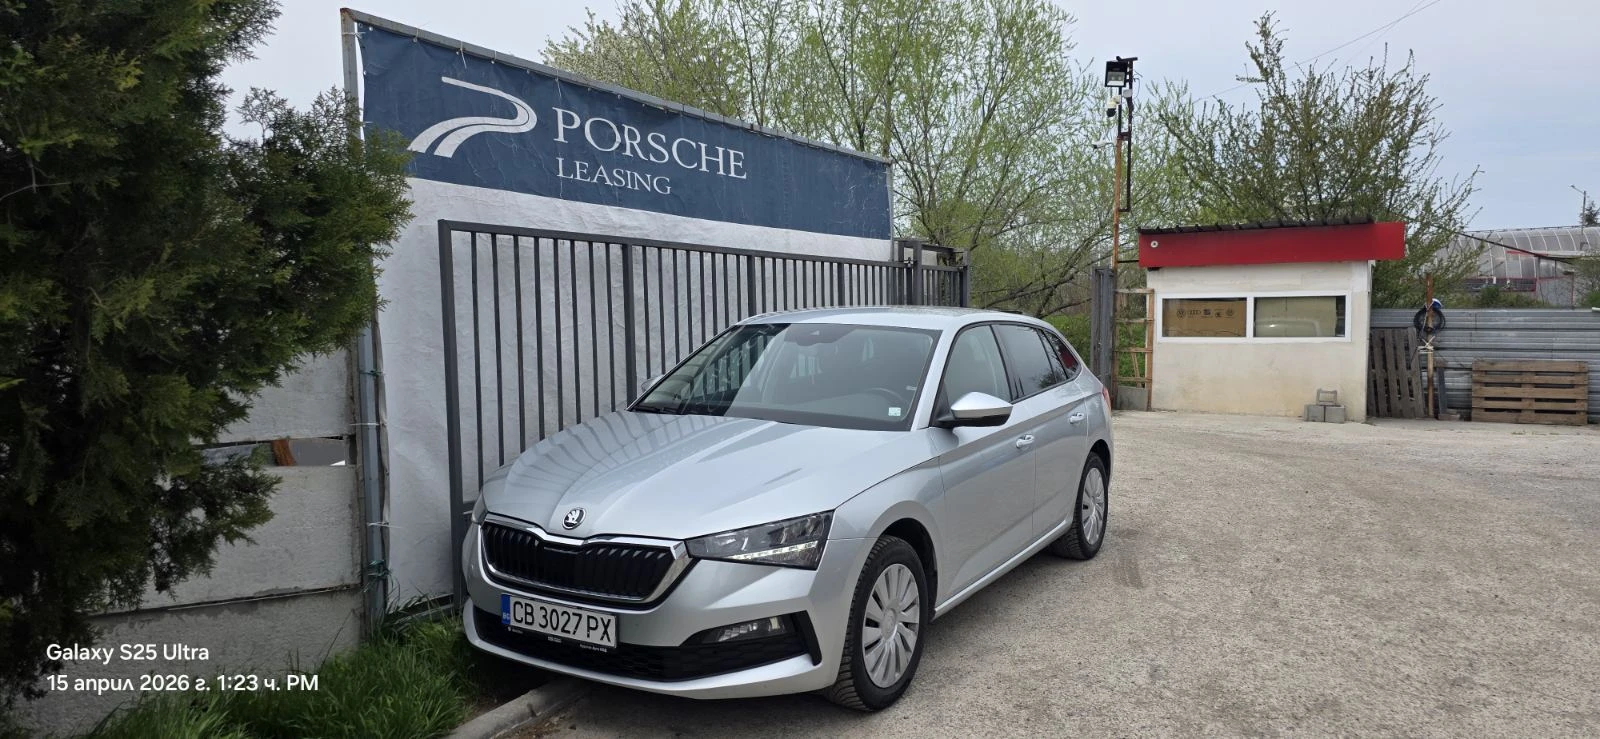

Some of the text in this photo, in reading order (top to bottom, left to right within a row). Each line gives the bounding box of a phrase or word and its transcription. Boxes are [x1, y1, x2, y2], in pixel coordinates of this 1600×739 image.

[552, 107, 747, 179] PORSCHE
[556, 157, 672, 195] LEASING
[513, 601, 612, 643] CB 3027 PX
